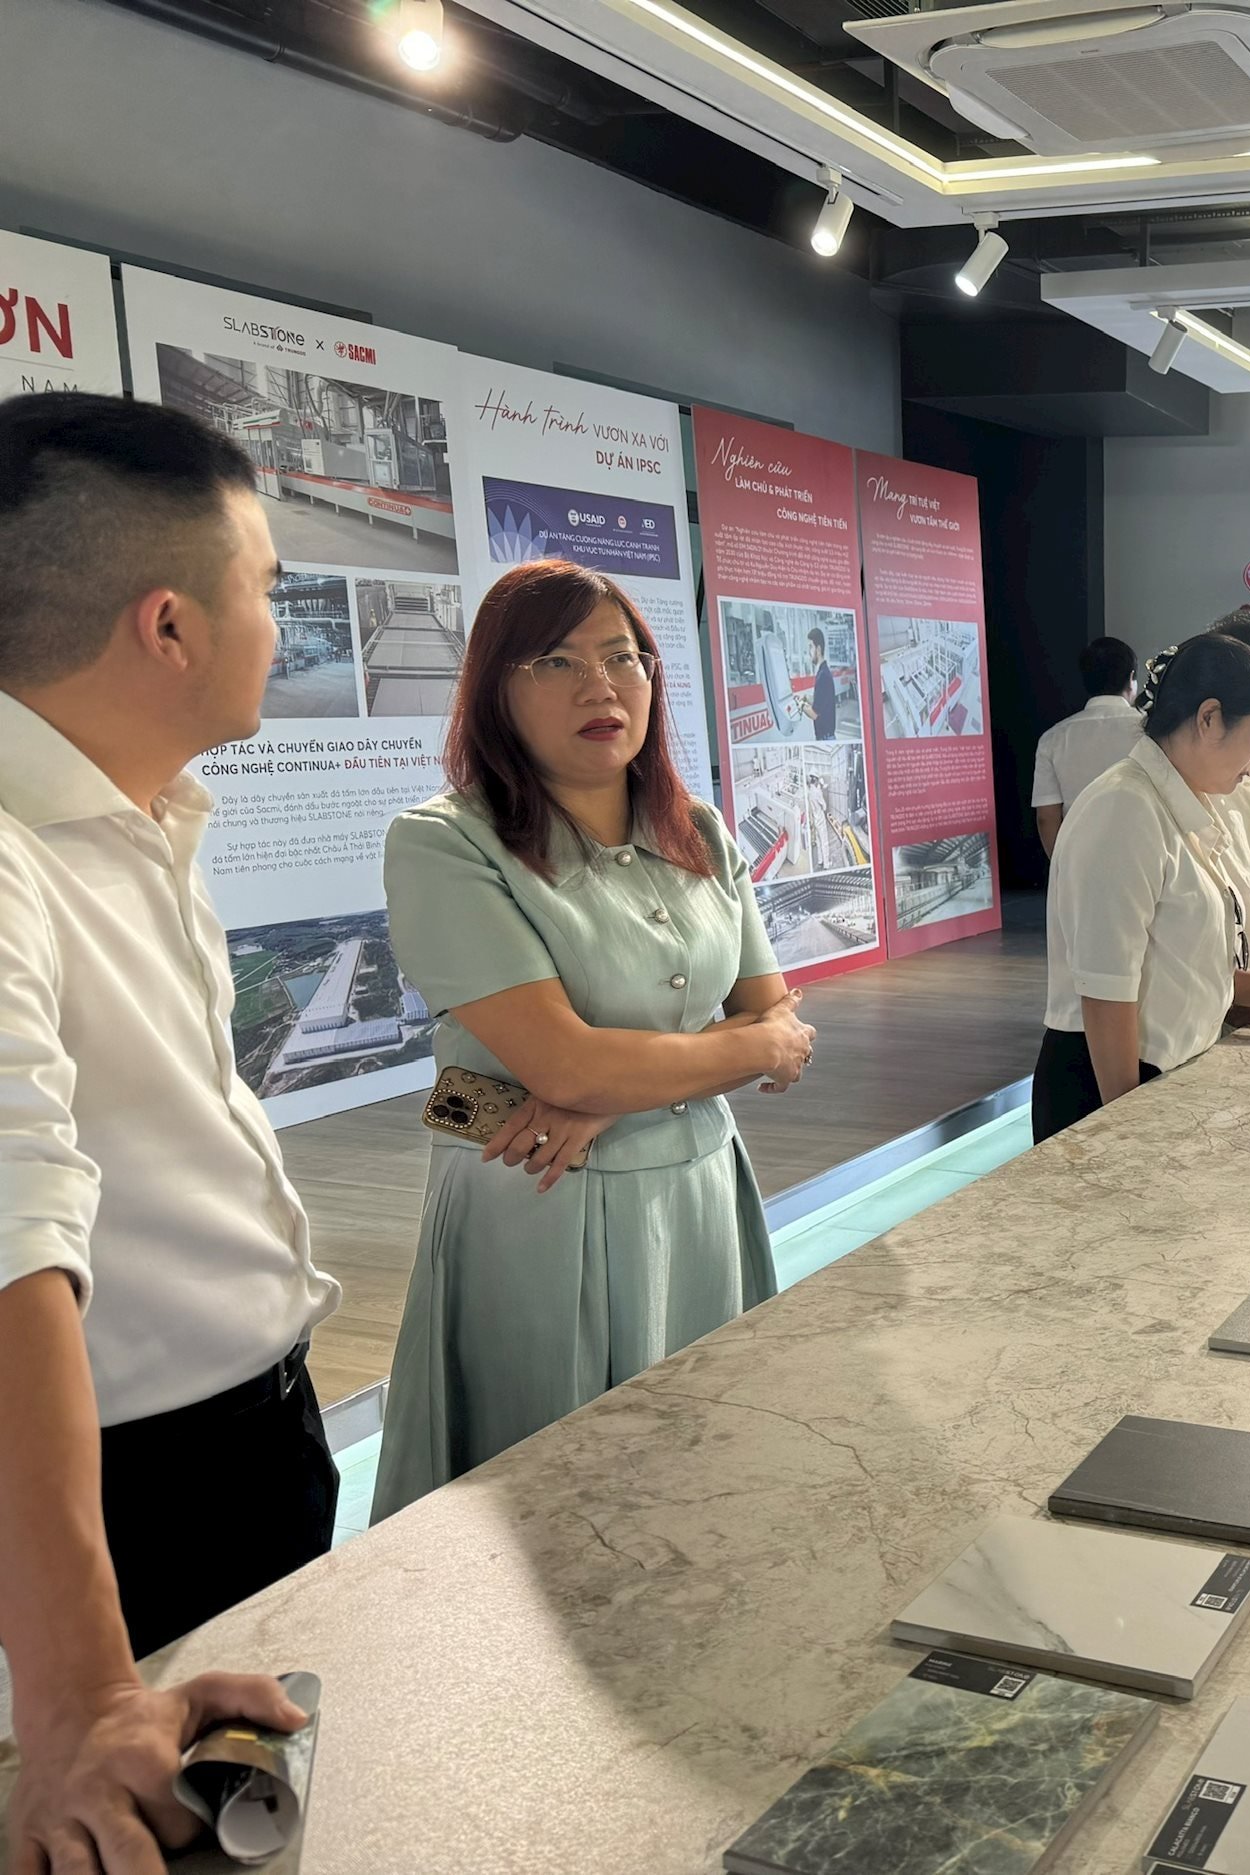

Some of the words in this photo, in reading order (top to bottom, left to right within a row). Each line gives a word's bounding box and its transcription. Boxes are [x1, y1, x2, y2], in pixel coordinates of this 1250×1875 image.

[348, 344, 377, 365] SACMI
[475, 388, 538, 431] Hành
[592, 423, 629, 444] VƯƠN
[631, 431, 647, 448] XA
[649, 434, 669, 452] VỚI
[595, 450, 614, 470] DỰ
[617, 451, 633, 470] ÁN
[636, 457, 662, 475] IPSC
[711, 436, 764, 481] Nghiên
[734, 475, 751, 490] LÀM
[751, 480, 767, 493] CHỦ
[768, 485, 774, 495] &
[774, 485, 792, 499] PHÁT
[866, 476, 909, 521] Mang
[929, 498, 941, 512] VIỆT
[579, 512, 606, 526] USAID
[776, 506, 797, 521] CÔNG
[798, 512, 817, 527] NGHỆ
[230, 741, 255, 755] TÁC
[258, 740, 275, 754] VÀ
[277, 739, 324, 754] CHUYỂN
[327, 740, 355, 752] GIAO
[357, 737, 378, 751] DÂY
[201, 761, 238, 776] CÔNG
[241, 759, 275, 776] NGHỆ
[276, 760, 341, 773] CONTINUA+
[344, 756, 367, 769] ĐẦU
[368, 755, 391, 768] TIÊN
[393, 757, 409, 770] TẠI
[410, 754, 431, 769] VIỆT
